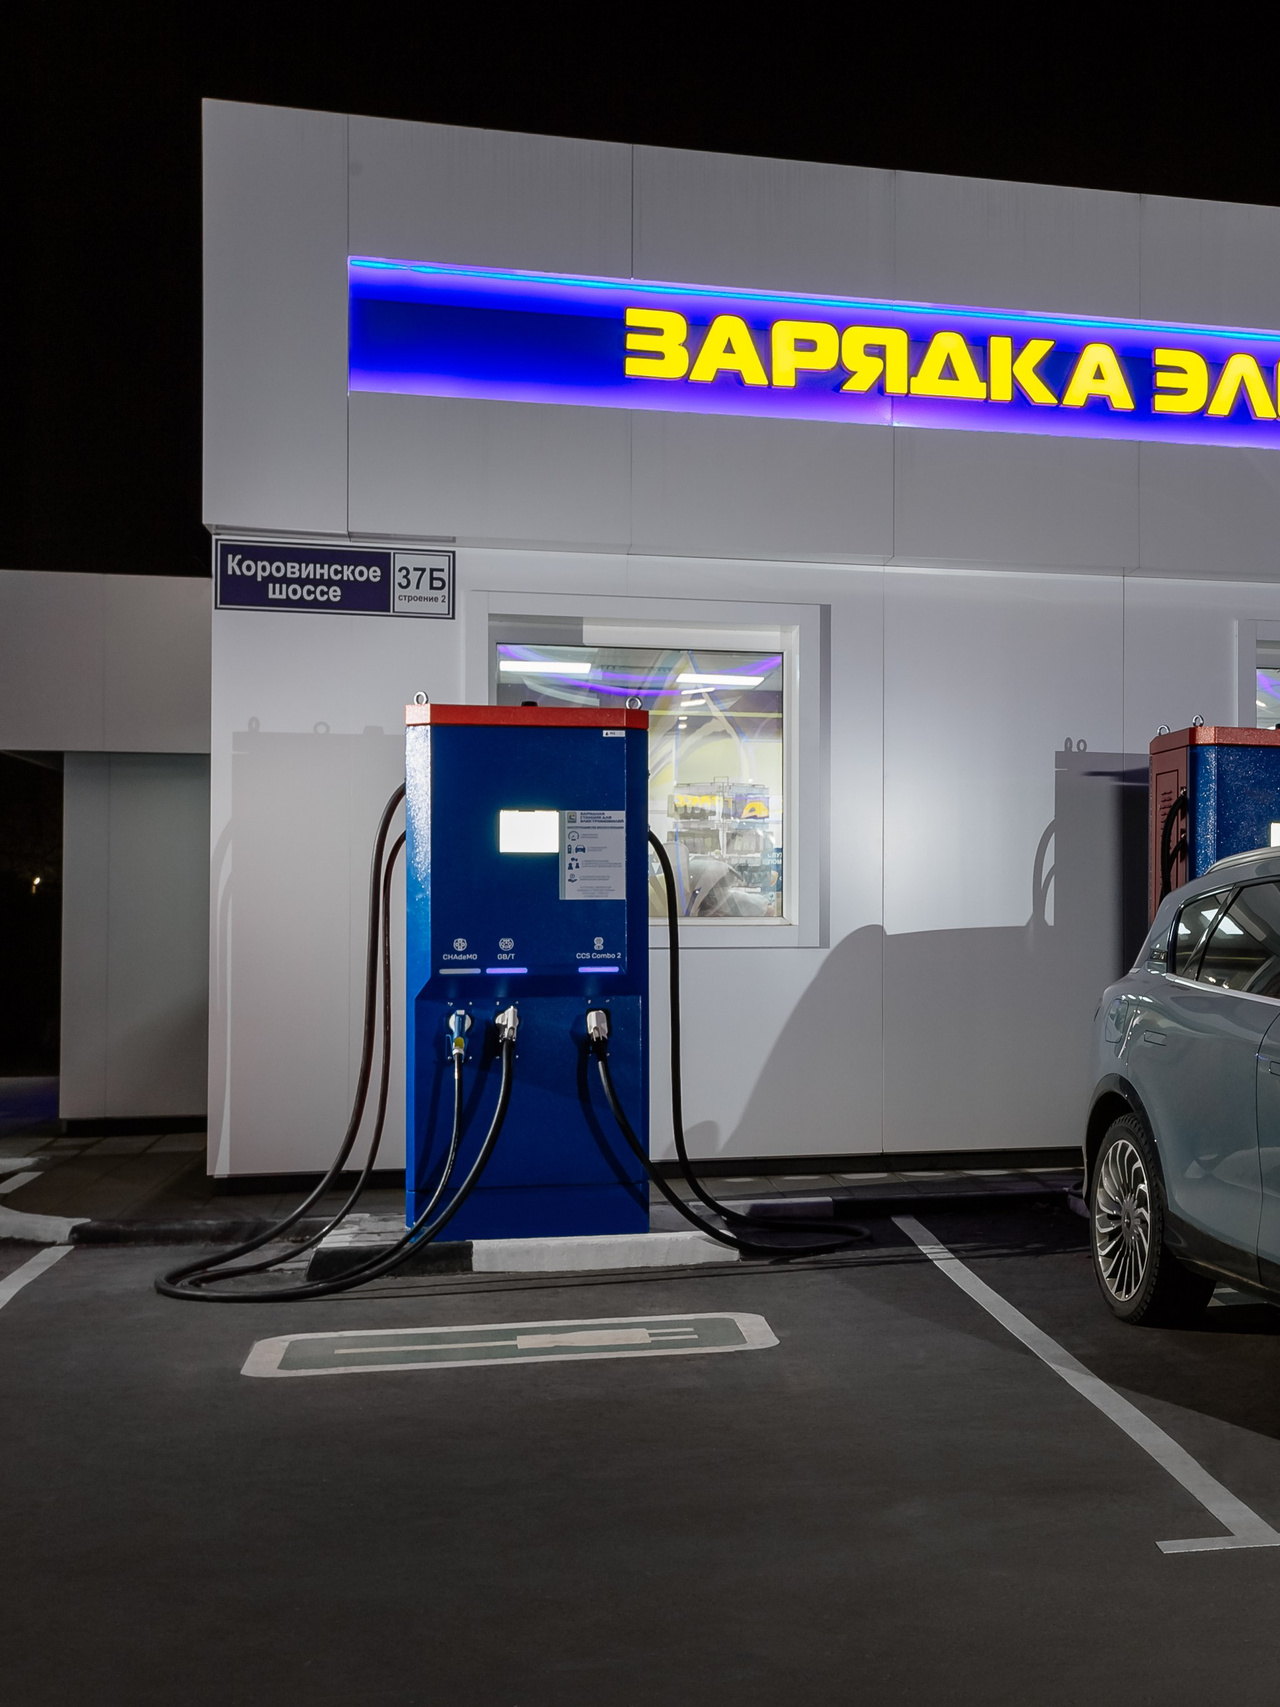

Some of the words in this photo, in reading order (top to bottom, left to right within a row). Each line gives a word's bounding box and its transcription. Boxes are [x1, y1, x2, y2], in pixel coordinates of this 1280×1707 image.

[624, 307, 1136, 411] ЗАРЯДКА
[227, 554, 382, 582] Коровинское
[397, 566, 447, 591] 37Б
[268, 582, 342, 602] шоссе
[398, 593, 438, 603] строение
[440, 594, 447, 603] 2
[442, 953, 478, 961] CHAdeMO
